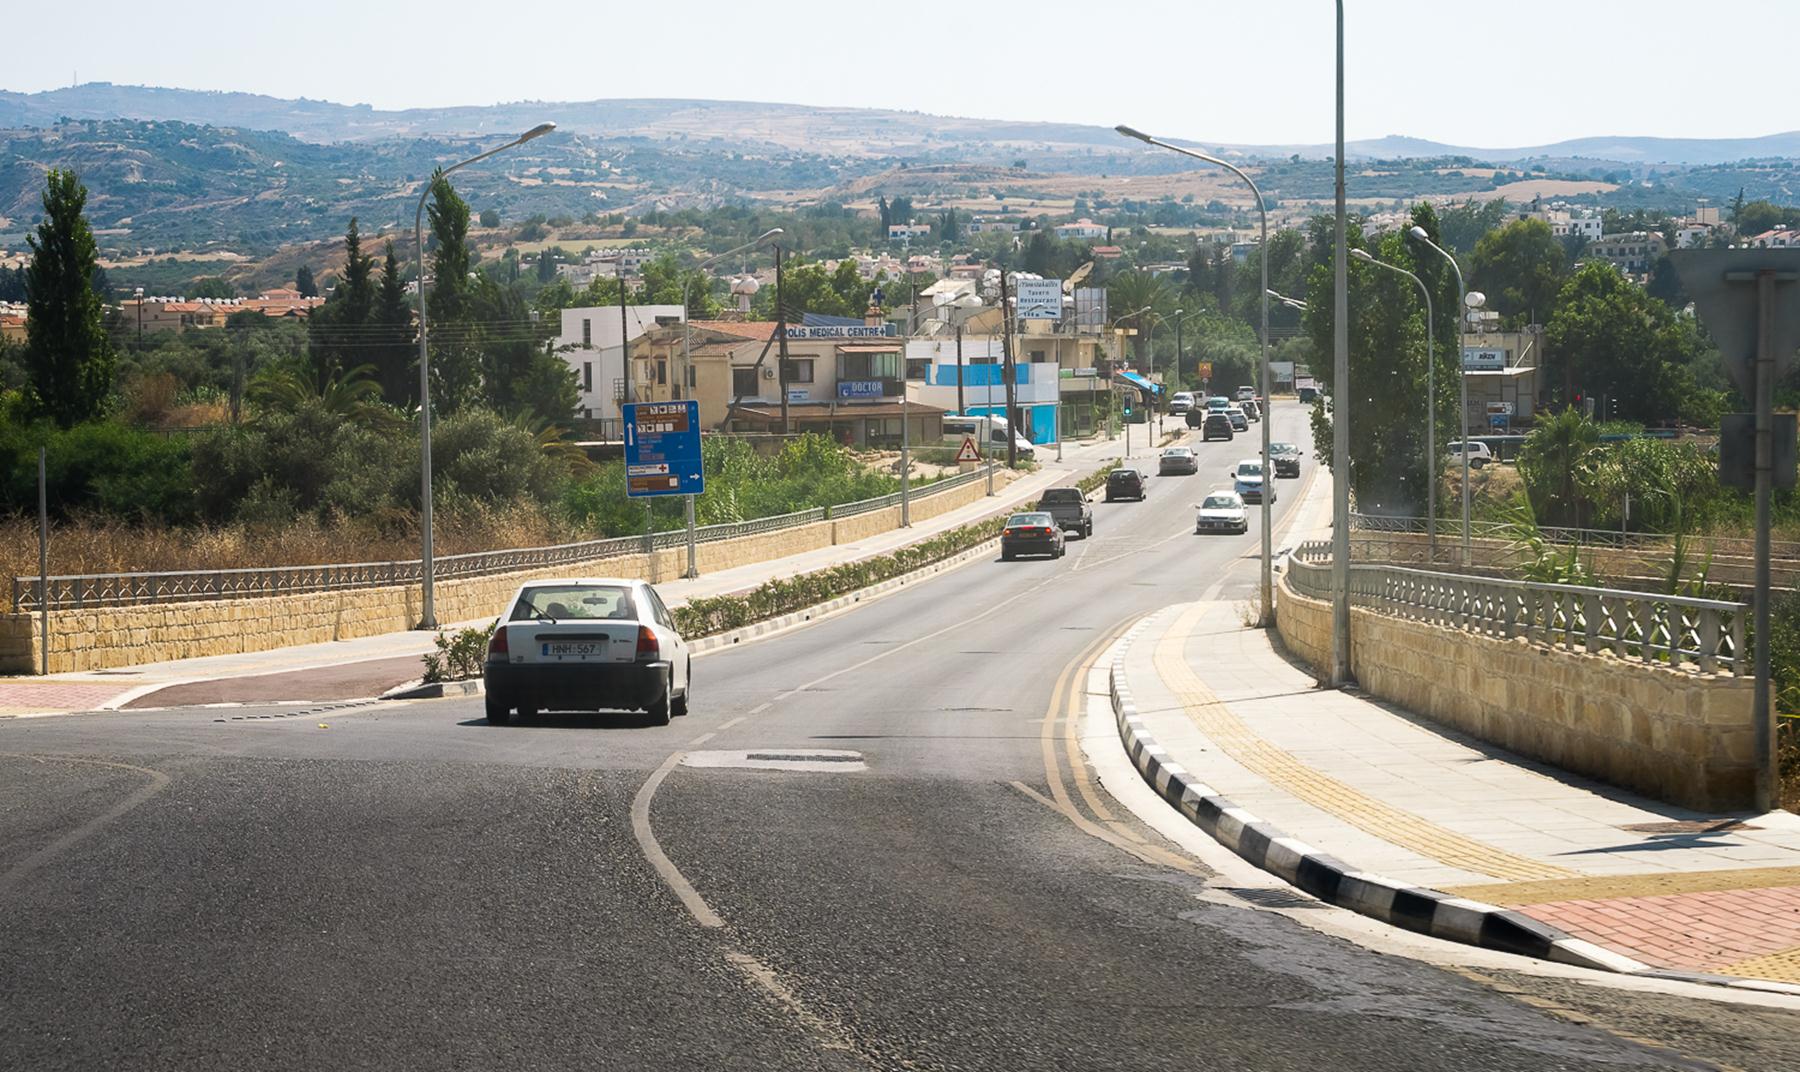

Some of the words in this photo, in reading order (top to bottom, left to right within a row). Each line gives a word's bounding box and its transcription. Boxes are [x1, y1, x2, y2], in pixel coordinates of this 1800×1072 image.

[809, 327, 845, 337] MEDICAL
[847, 327, 880, 336] CENTRE
[851, 382, 882, 392] DOCTOR
[552, 644, 571, 654] HNH
[577, 644, 596, 654] 567
